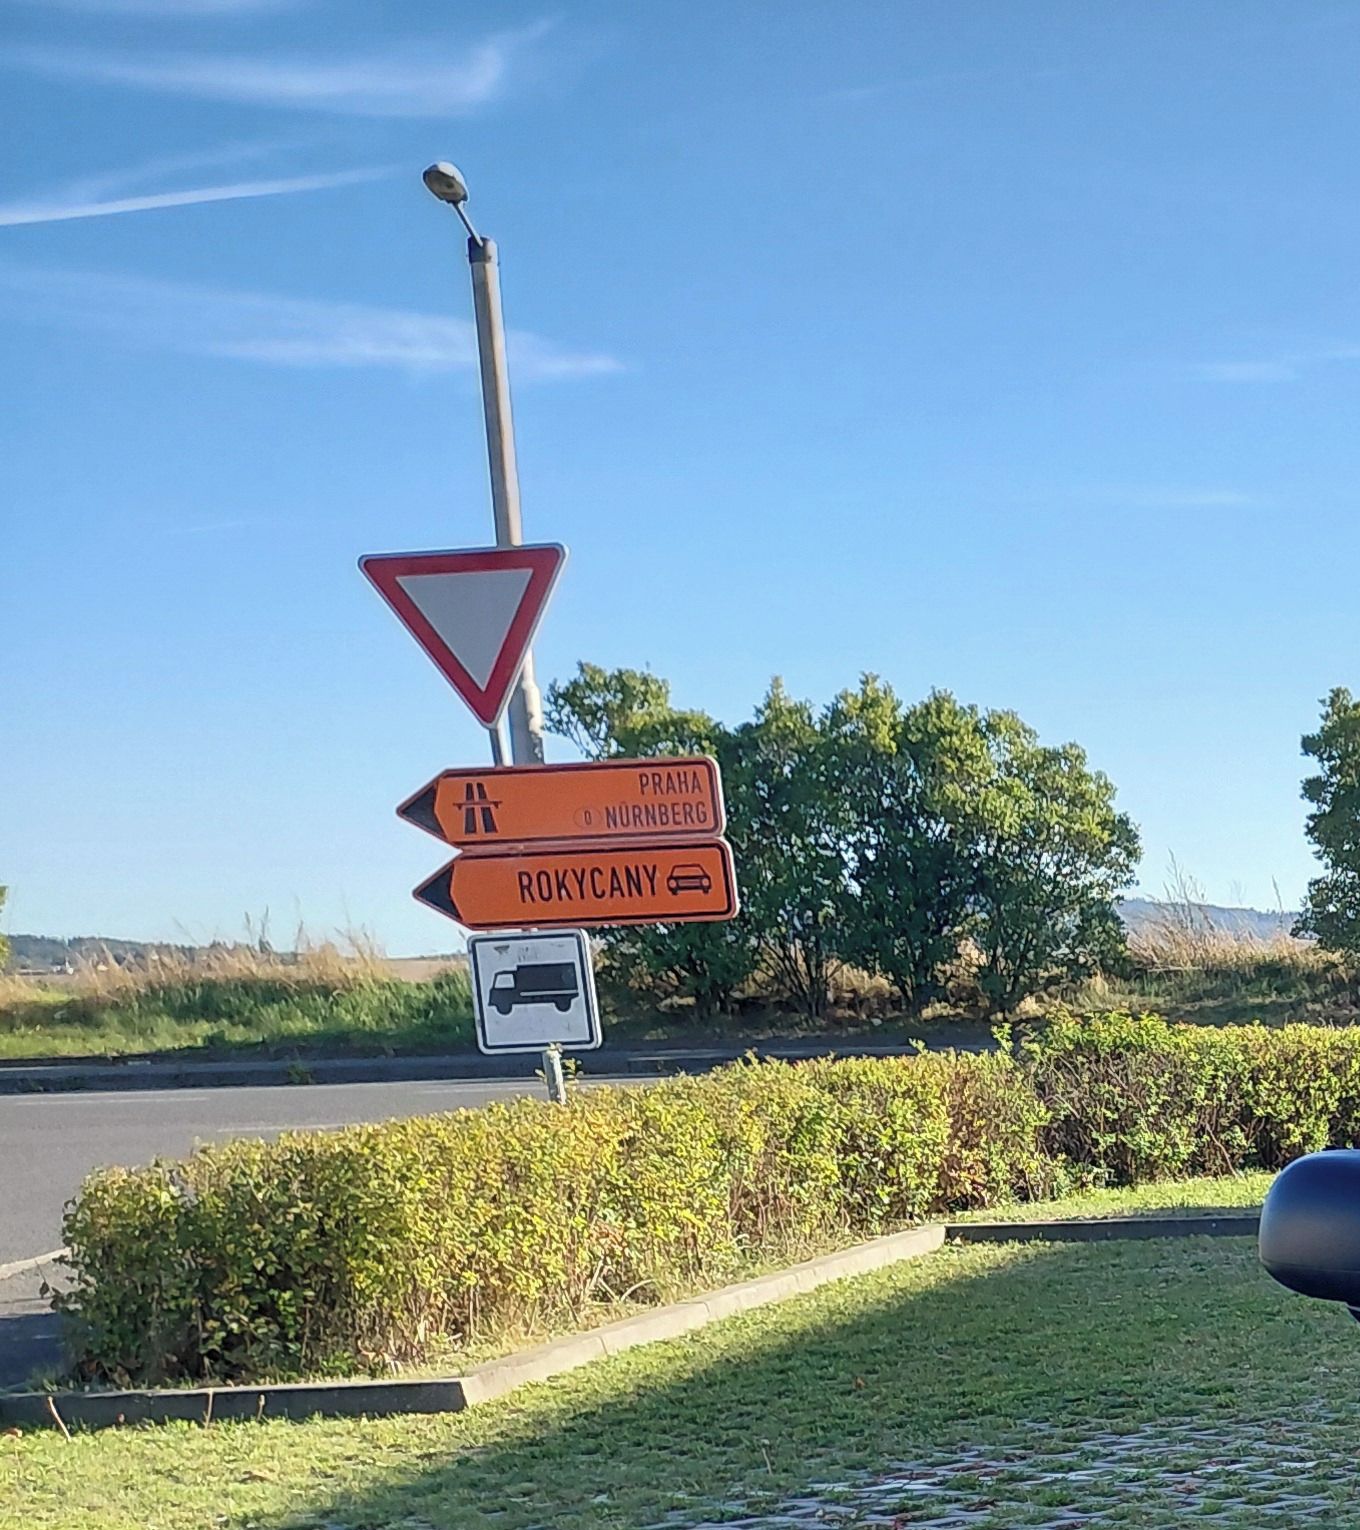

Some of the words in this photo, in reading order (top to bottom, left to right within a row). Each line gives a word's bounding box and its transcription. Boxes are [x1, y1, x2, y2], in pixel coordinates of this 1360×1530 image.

[639, 771, 703, 796] PRAHA
[605, 801, 708, 829] NÜRNBERG
[517, 865, 658, 904] ROKYCANY
